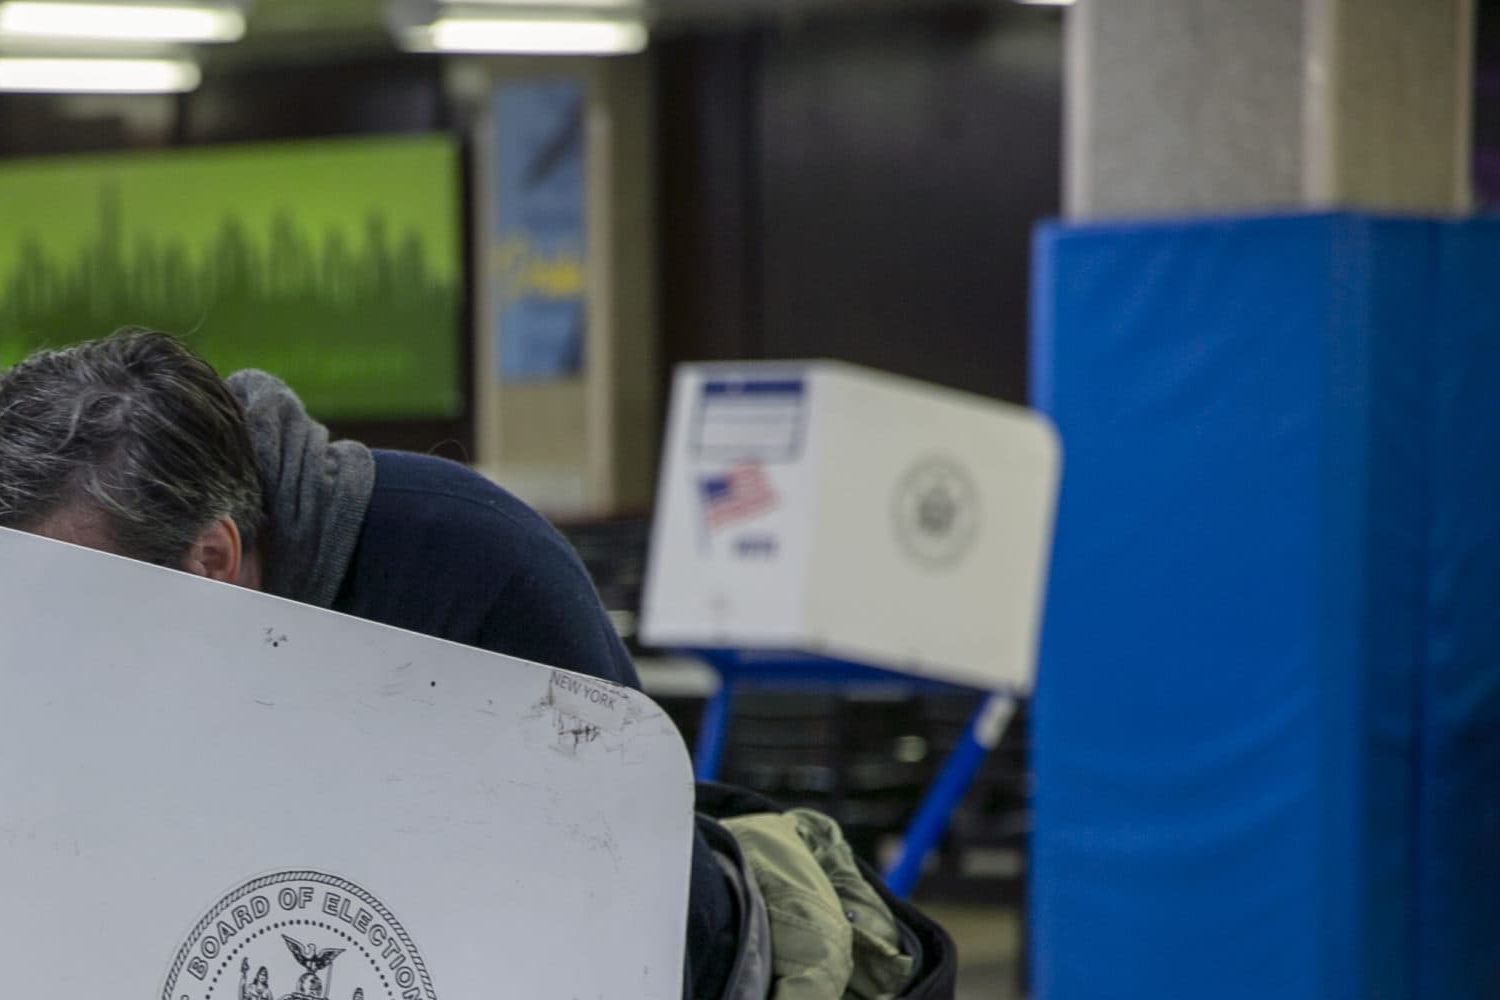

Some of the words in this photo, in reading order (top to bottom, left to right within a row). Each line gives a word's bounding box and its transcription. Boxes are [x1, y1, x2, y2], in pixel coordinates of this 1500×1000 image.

[551, 671, 582, 695] NEW
[583, 685, 616, 710] YORK
[187, 895, 270, 981] BOARD
[277, 886, 314, 911] OF
